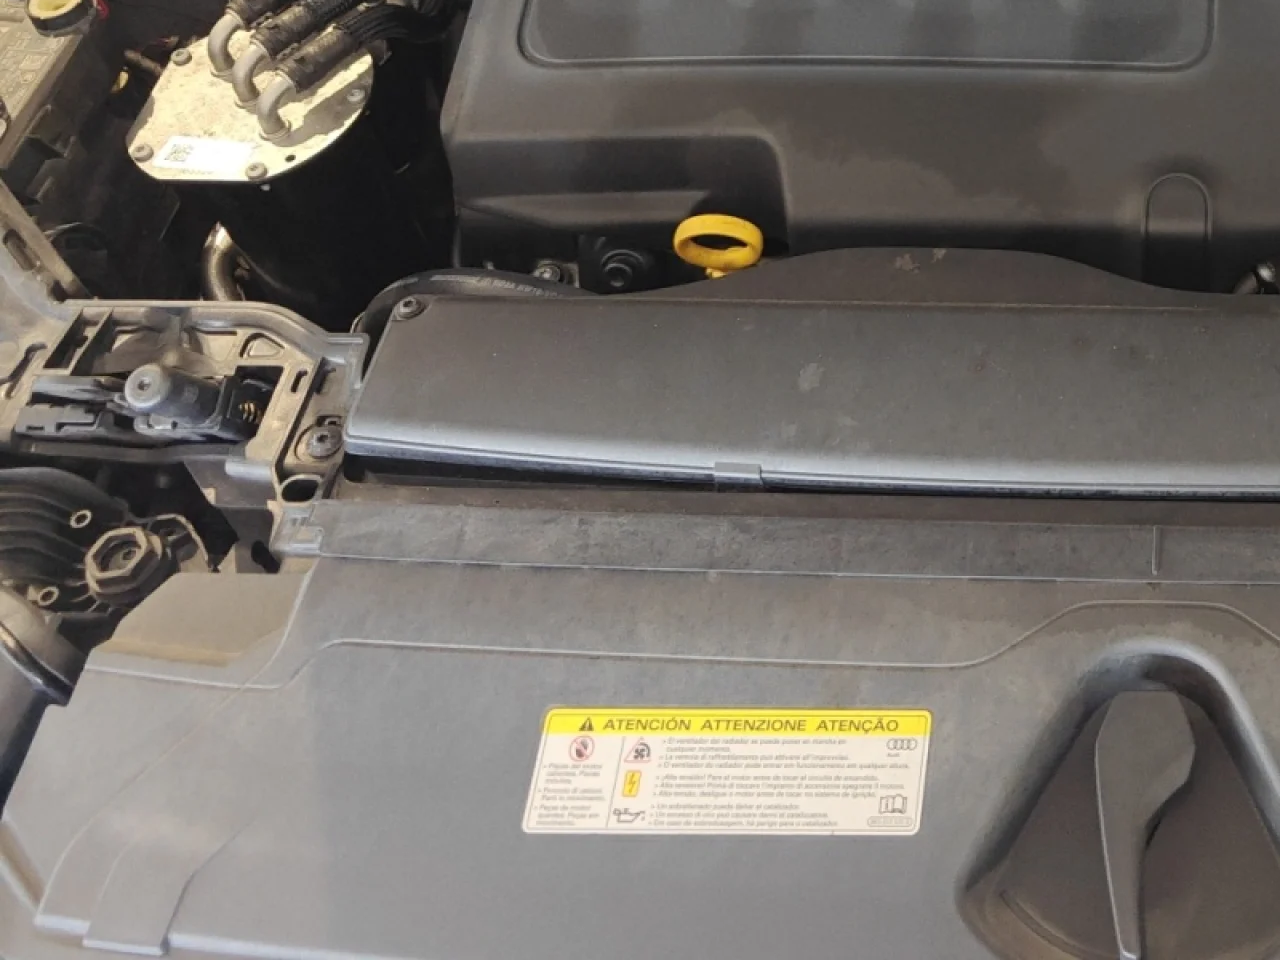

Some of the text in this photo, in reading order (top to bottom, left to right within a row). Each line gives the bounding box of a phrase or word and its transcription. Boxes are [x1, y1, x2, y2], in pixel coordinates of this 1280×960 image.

[602, 717, 900, 735] ATENCIÓN ATTENZIONE ATENÇÃO
